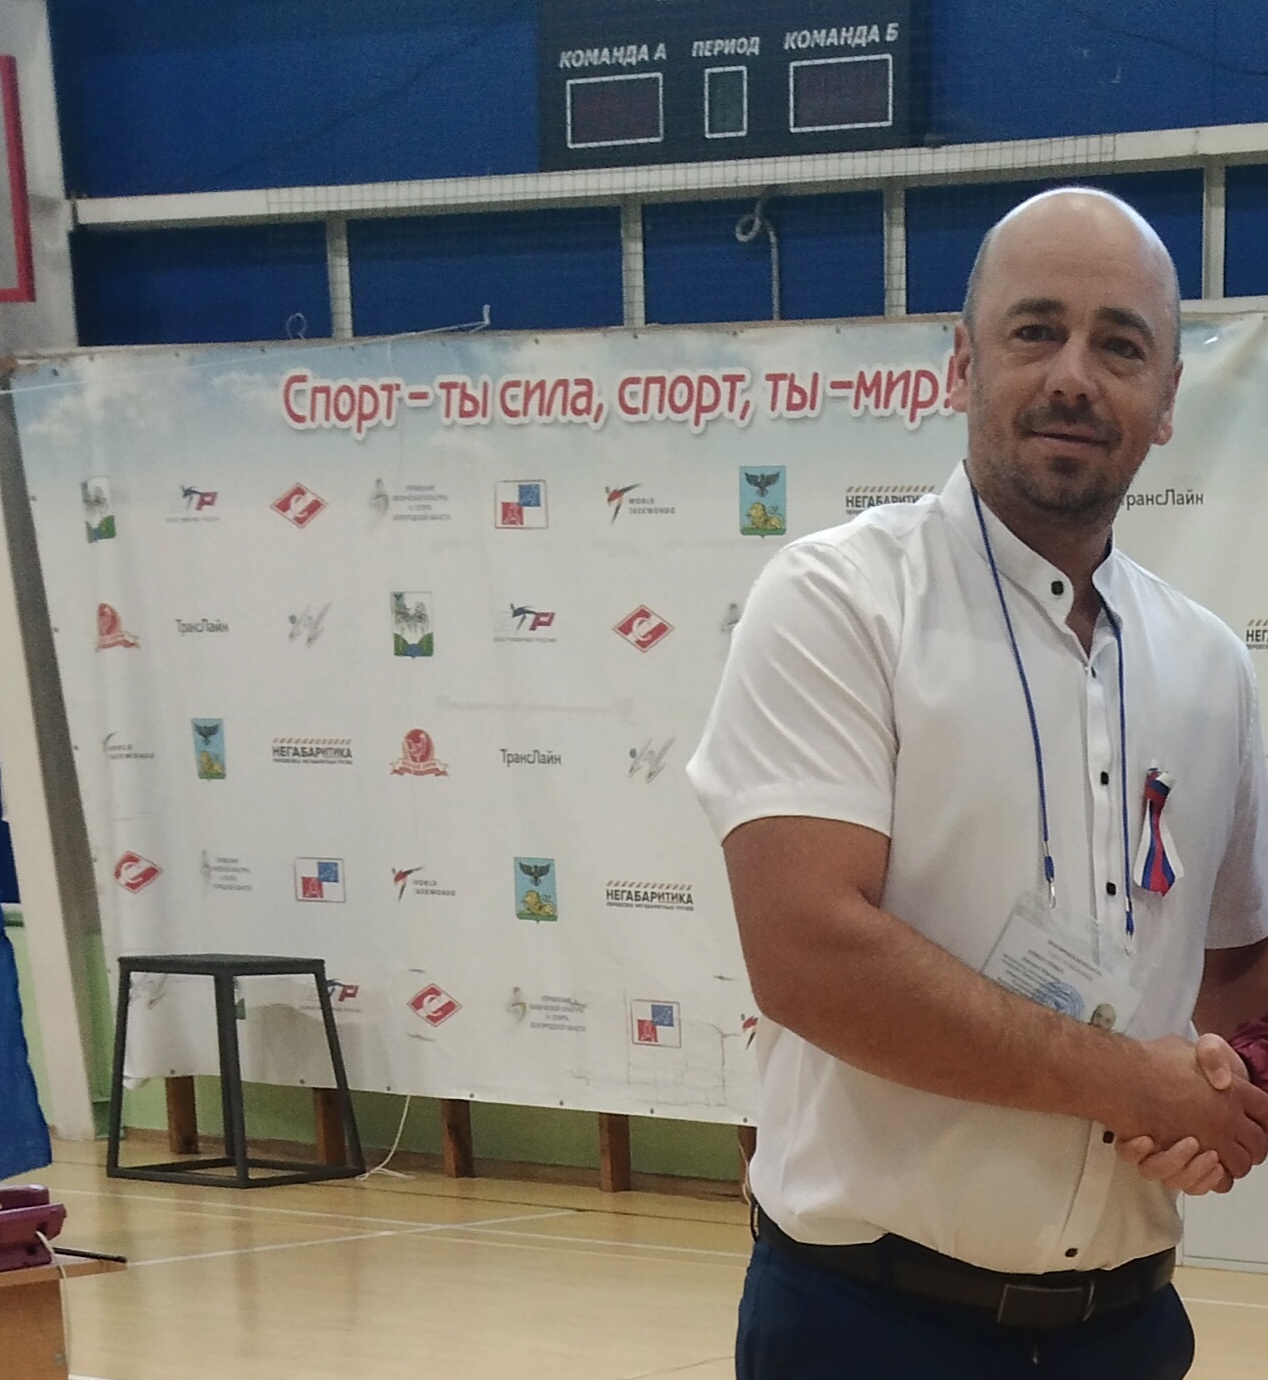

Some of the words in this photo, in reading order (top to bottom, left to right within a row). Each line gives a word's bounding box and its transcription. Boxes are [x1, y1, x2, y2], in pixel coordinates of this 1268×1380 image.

[691, 36, 761, 58] ПЕРИОД
[784, 23, 880, 51] КОМАНДА
[884, 22, 900, 42] Б
[559, 44, 649, 68] КОМАНДА
[653, 42, 668, 61] А
[283, 374, 402, 434] Спорт
[438, 380, 489, 419] ты
[500, 378, 605, 423] сила,
[618, 373, 750, 427] спорт,
[765, 371, 820, 412] ты
[1122, 488, 1204, 510] рансЛайн
[500, 748, 562, 767] ТрансЛайн
[606, 889, 694, 905] НЕГАБАРИТИКА
